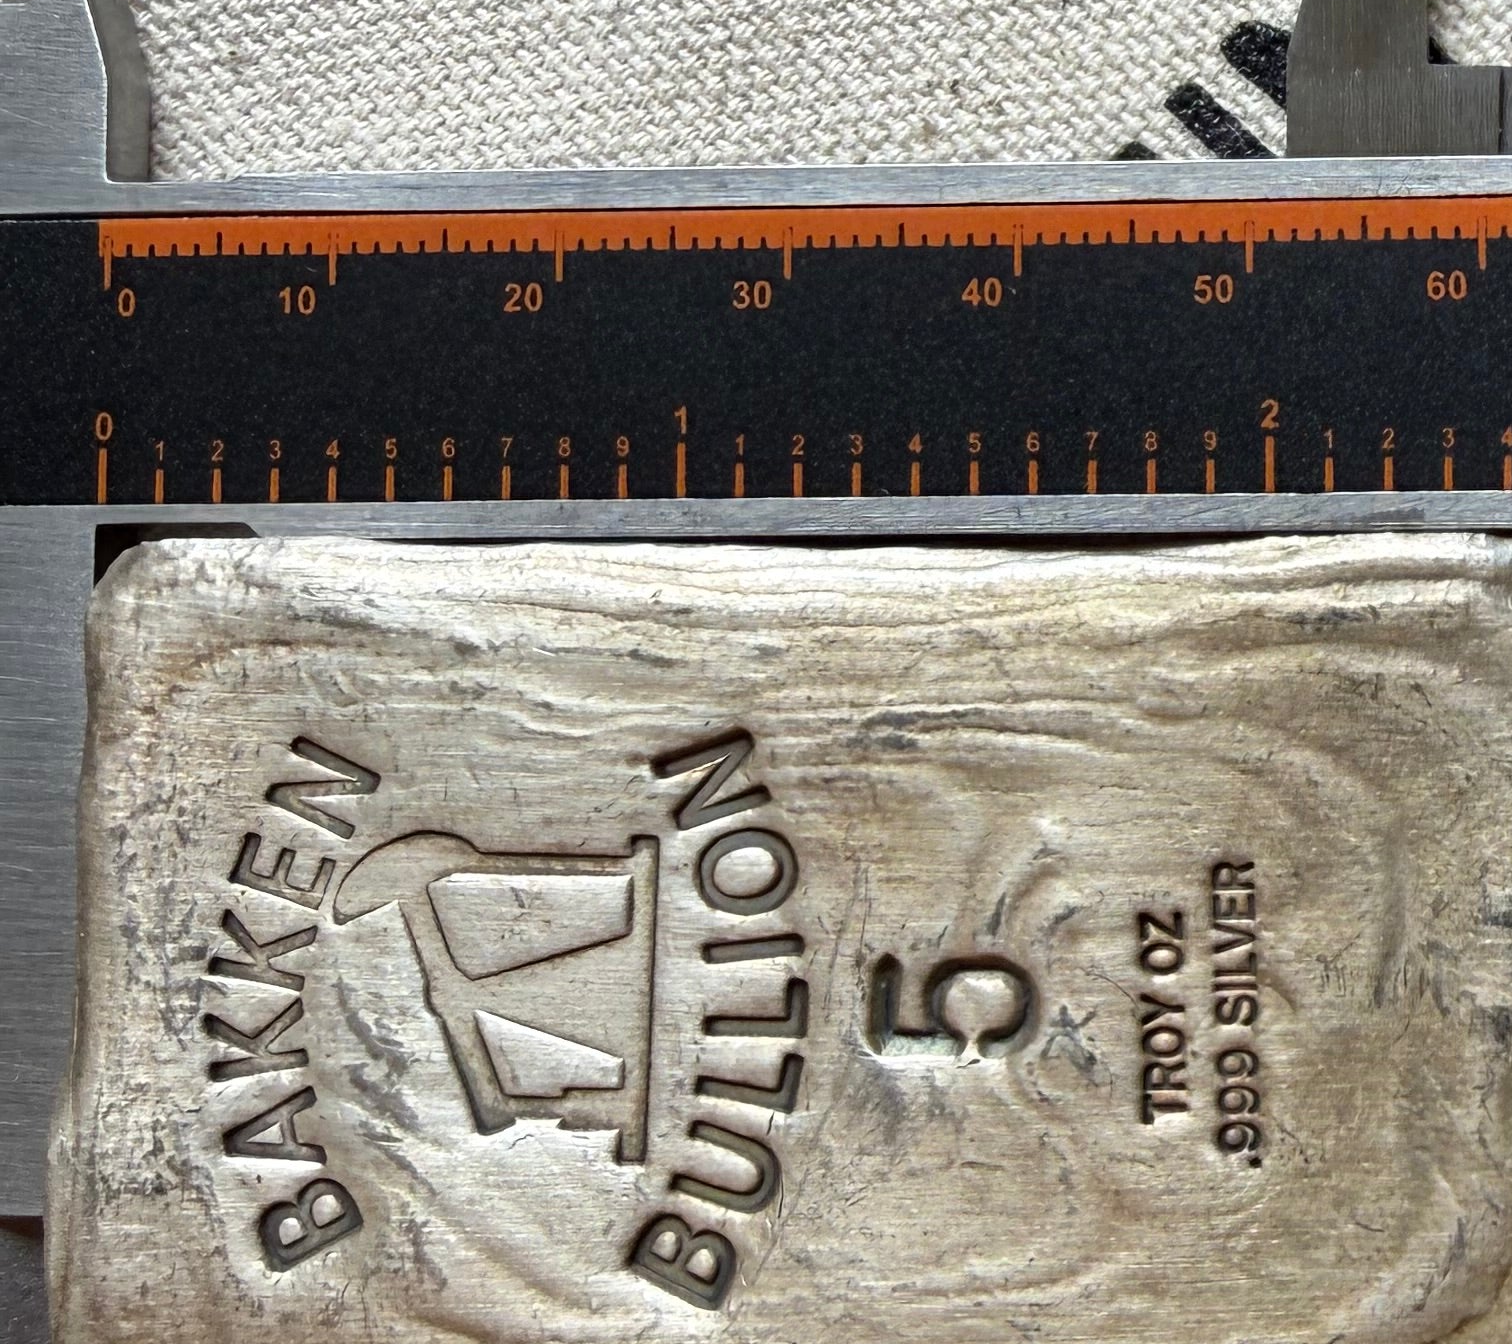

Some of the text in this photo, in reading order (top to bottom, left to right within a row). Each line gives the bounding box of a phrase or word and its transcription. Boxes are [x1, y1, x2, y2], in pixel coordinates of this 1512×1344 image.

[117, 270, 1468, 317] 0 10 20 30 40 50 60
[95, 411, 114, 441] 0
[155, 442, 164, 460] 1
[212, 441, 224, 460] 2
[269, 440, 281, 459] 3
[326, 440, 340, 459] 4
[385, 439, 397, 458] 5
[442, 439, 455, 458] 6
[502, 438, 513, 457] 7
[559, 437, 571, 457] 8
[617, 437, 629, 456] 9
[674, 406, 688, 434] 1
[735, 436, 744, 455] 1
[792, 436, 804, 455] 2
[851, 434, 863, 453] 3
[909, 433, 923, 452] 4
[968, 433, 981, 452] 5
[1026, 432, 1039, 451] 6
[1086, 432, 1098, 451] 7
[1145, 431, 1157, 450] 8
[1204, 431, 1217, 450] 9
[1260, 399, 1279, 429] 2
[1324, 430, 1334, 449] 1
[1382, 430, 1395, 449] 2
[1442, 429, 1454, 448] 3
[202, 735, 381, 1272] BAKKEN
[627, 727, 809, 1311] BULLION
[868, 953, 1038, 1059] 5
[1138, 911, 1190, 1126] TROY OZ
[1212, 861, 1263, 1168] .999 SILVER
